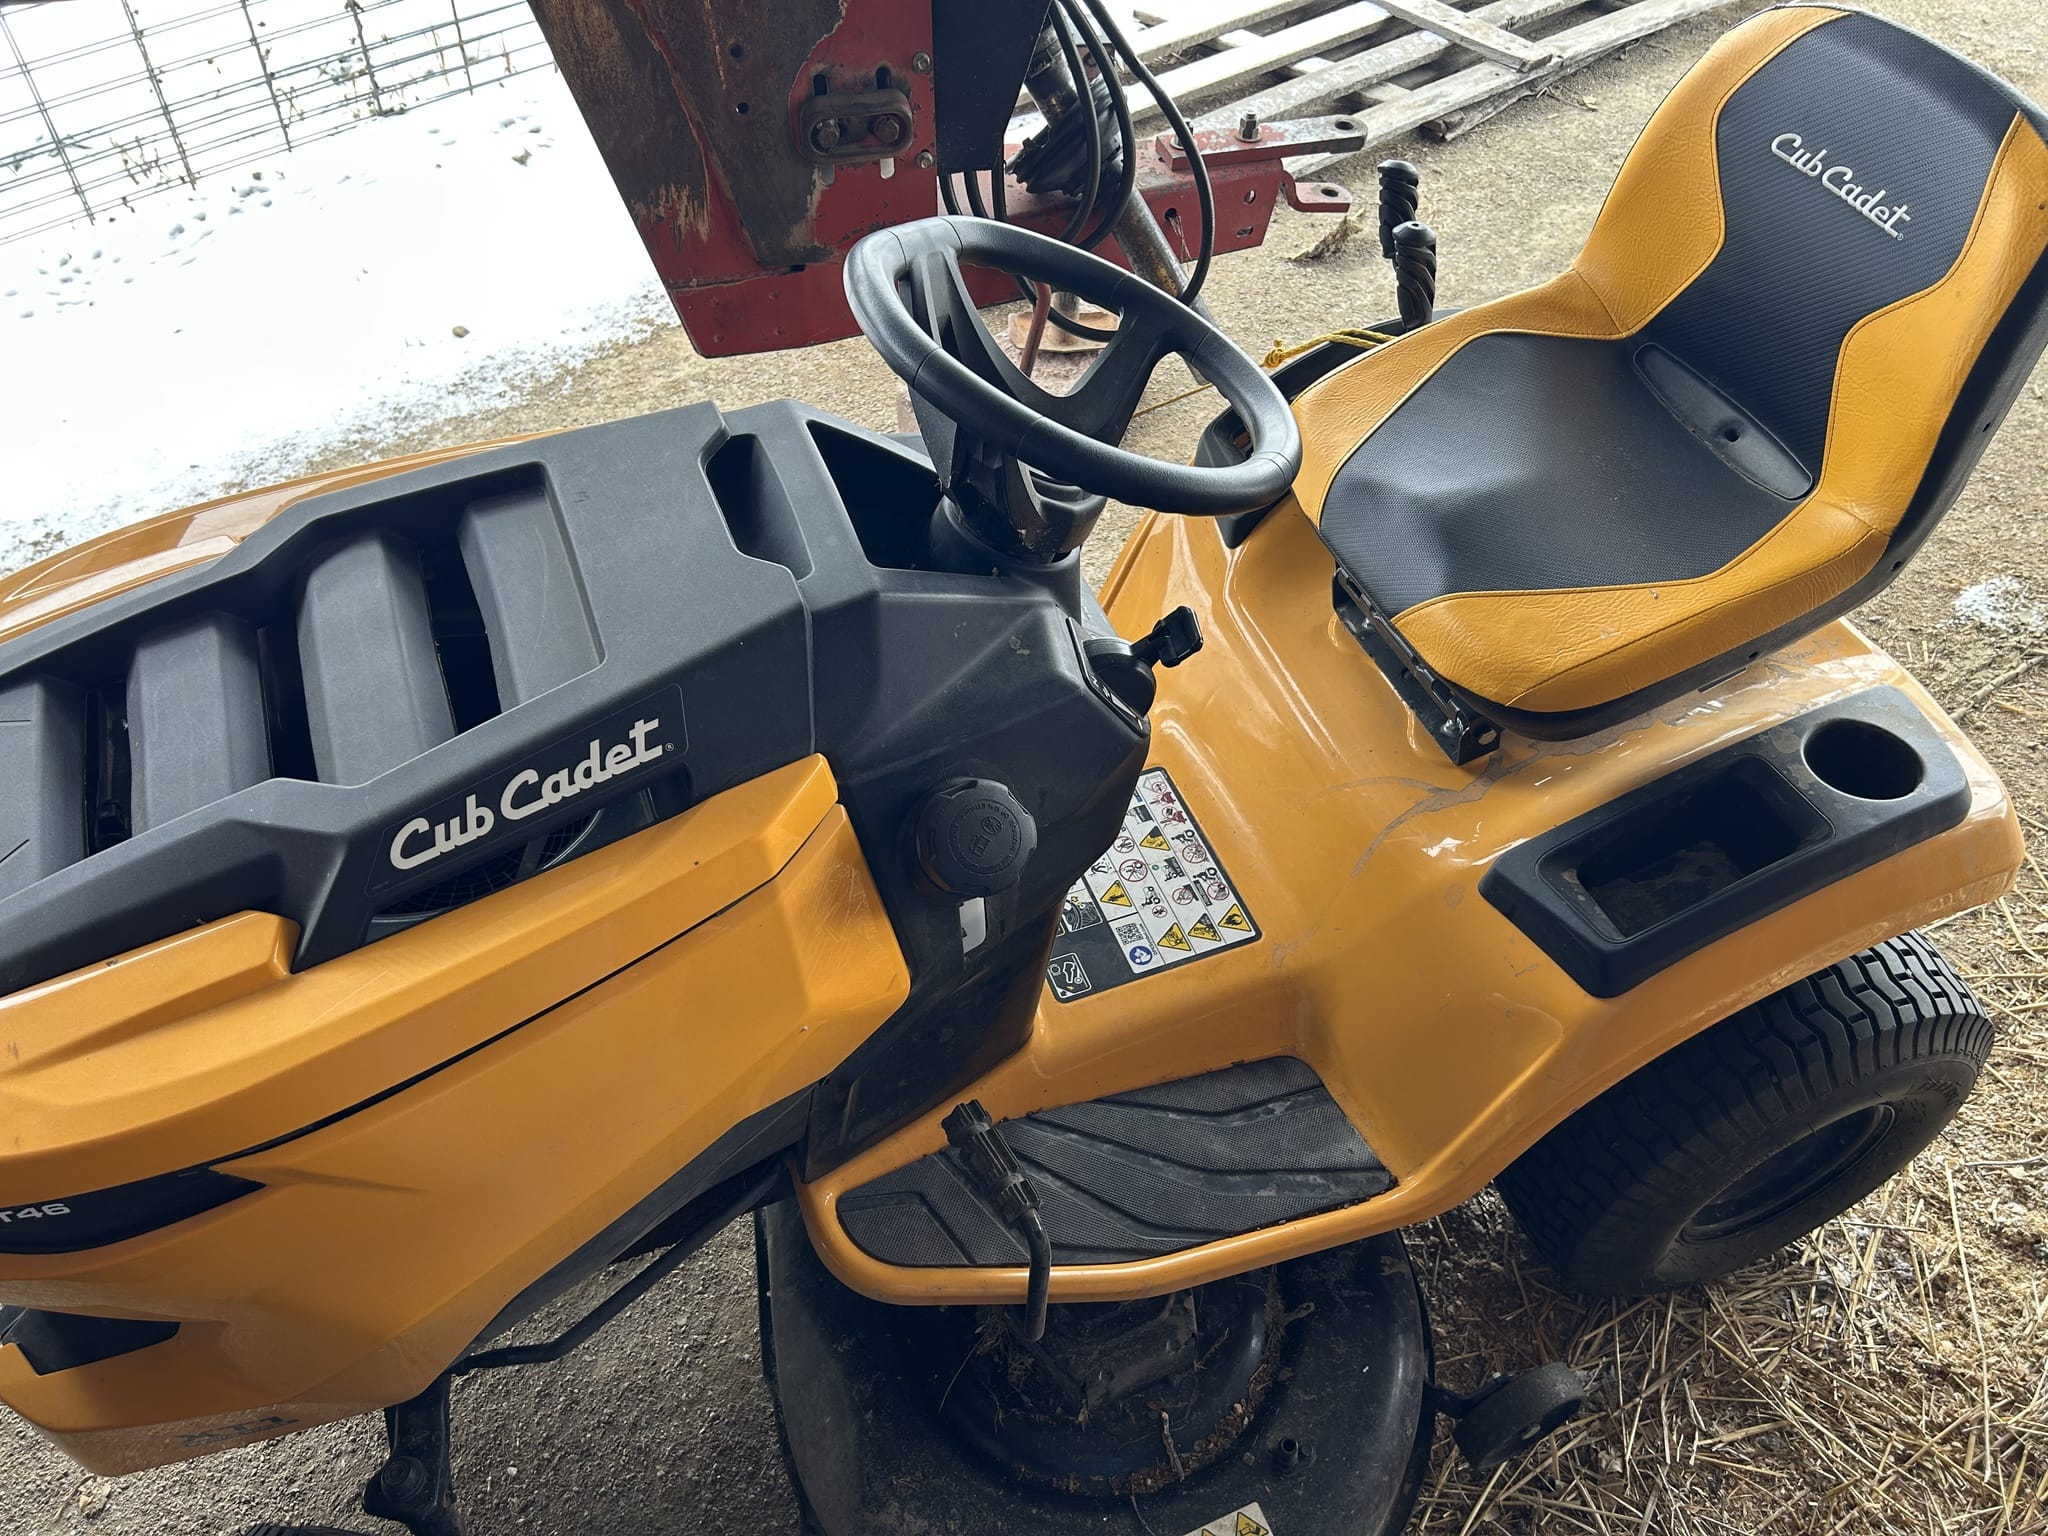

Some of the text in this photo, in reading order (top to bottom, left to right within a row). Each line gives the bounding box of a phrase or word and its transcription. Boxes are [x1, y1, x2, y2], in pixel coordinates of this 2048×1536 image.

[1771, 133, 1911, 238] Cub Cadet
[390, 718, 663, 870] Cub Cadet
